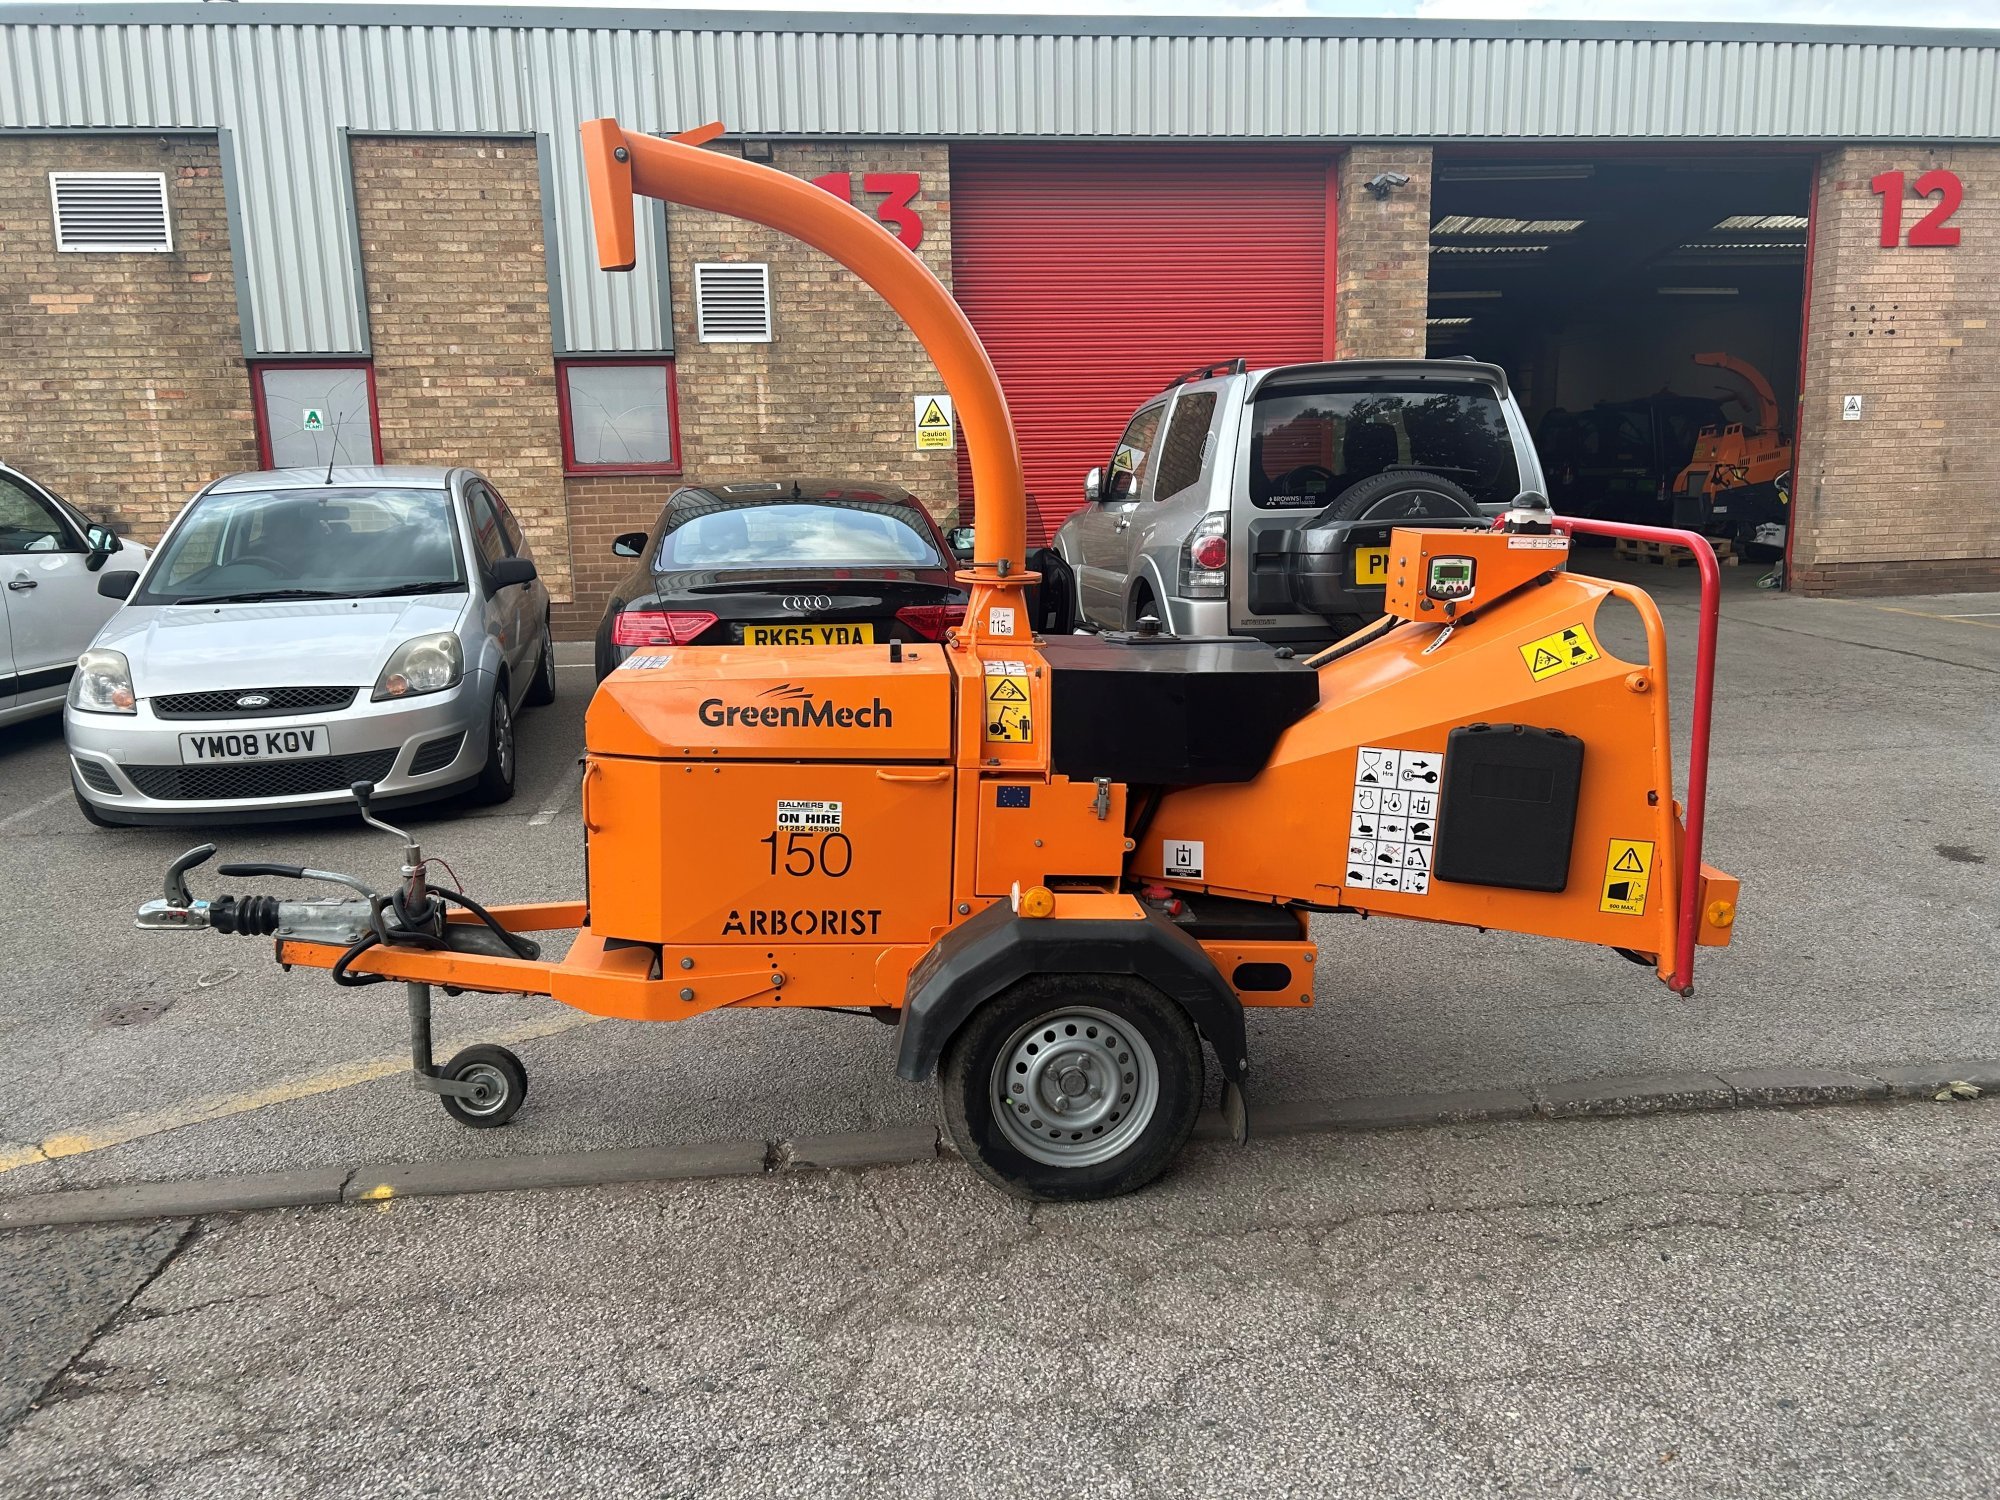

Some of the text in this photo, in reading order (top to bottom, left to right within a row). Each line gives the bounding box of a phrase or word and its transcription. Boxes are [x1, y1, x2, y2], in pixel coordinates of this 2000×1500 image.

[1872, 170, 1962, 247] 12
[306, 411, 321, 424] A
[755, 628, 814, 645] RK65
[698, 697, 893, 728] GreenMech
[191, 730, 315, 758] YM08 KOV
[1382, 770, 1394, 778] Hrs
[1385, 761, 1393, 770] 8
[779, 813, 840, 824] ON HIRE
[761, 831, 853, 877] 150
[721, 909, 882, 935] ARBORIST
